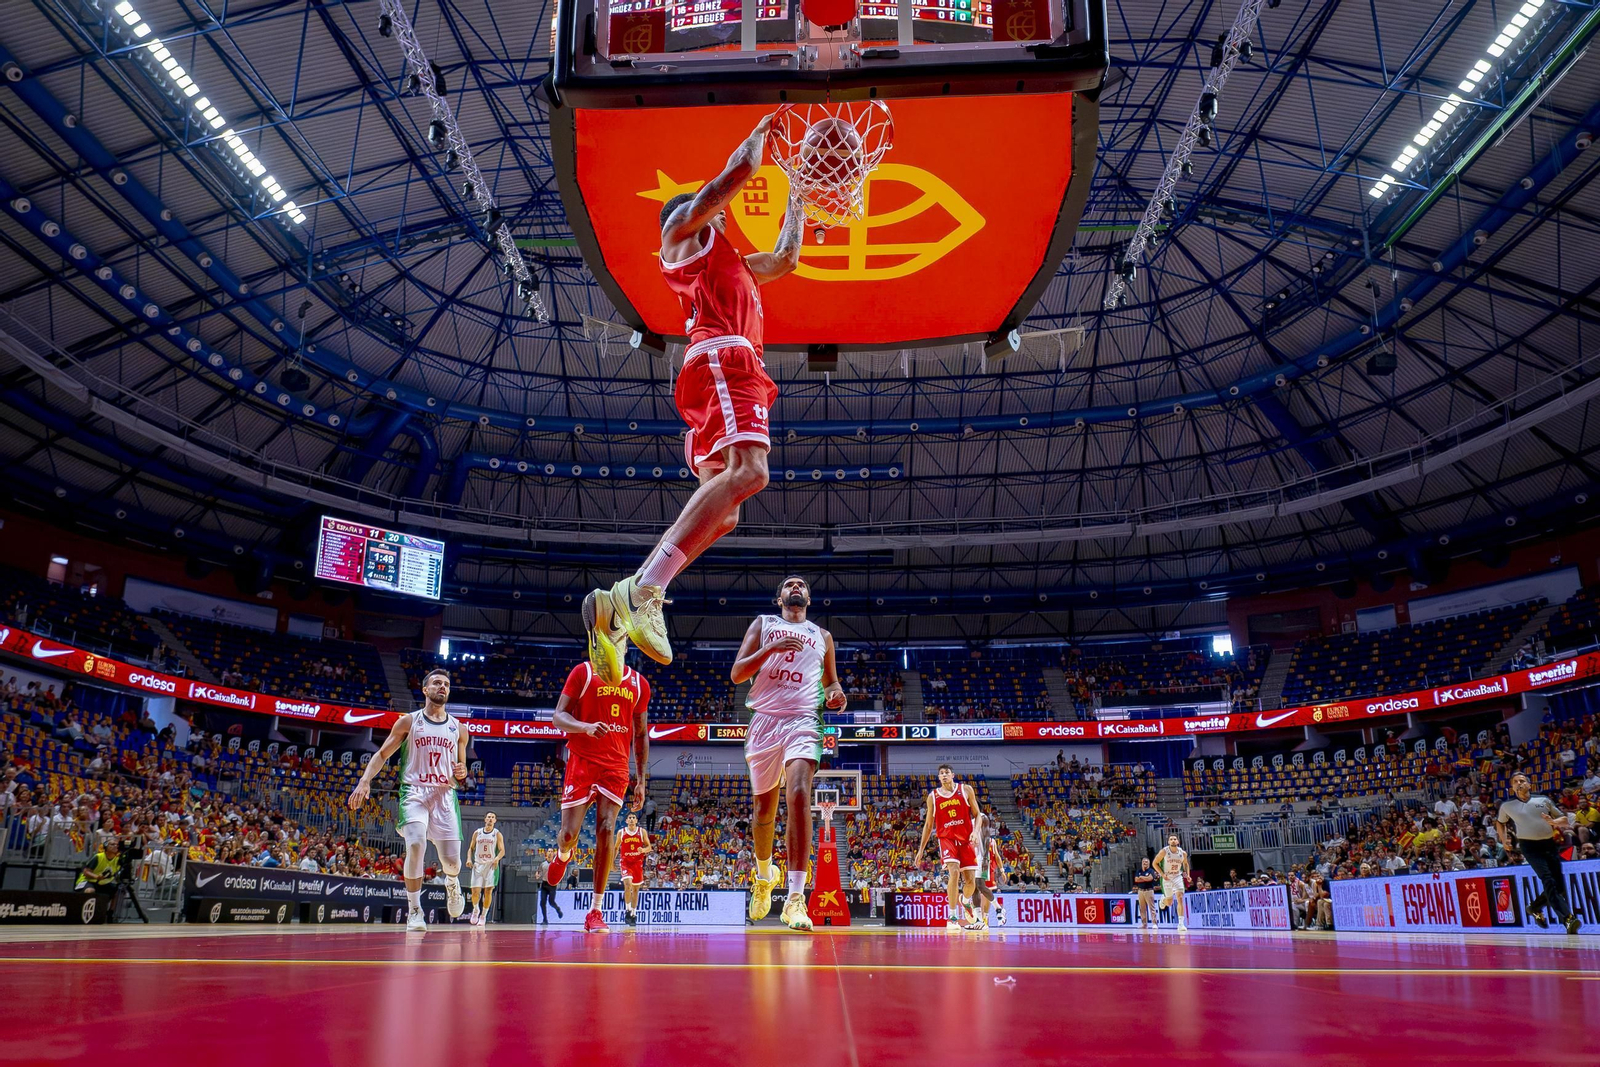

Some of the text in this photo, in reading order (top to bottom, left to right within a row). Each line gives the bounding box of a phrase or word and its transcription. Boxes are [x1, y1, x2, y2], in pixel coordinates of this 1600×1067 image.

[676, 6, 687, 15] 16
[676, 17, 686, 27] 17
[743, 176, 770, 217] FEB
[369, 528, 380, 539] 11
[387, 533, 400, 543] 20
[374, 552, 395, 564] 1:49
[785, 650, 796, 663] 3
[129, 673, 176, 693] endesa
[768, 668, 803, 684] una
[597, 686, 634, 703] ESPAÑA
[1454, 681, 1503, 700] CaixaBank
[207, 689, 251, 707] CaixaBank
[611, 703, 620, 718] 8
[1366, 698, 1420, 714] endesa
[462, 721, 491, 733] desa
[521, 725, 562, 736] CaixaBank
[881, 727, 897, 739] 23
[911, 727, 926, 739] 20
[951, 728, 997, 738] PORTUGAL
[1038, 725, 1085, 736] endesa
[1115, 723, 1160, 735] CaixaBank
[415, 736, 456, 754] PORTUGAL
[429, 751, 442, 768] 17
[419, 773, 449, 785] una
[948, 809, 957, 818] 16
[224, 875, 257, 890] endesa
[343, 885, 364, 896] endesa
[574, 892, 710, 911] MAID MISTAR ARENA
[1402, 872, 1458, 925] ESPAÑA
[812, 909, 844, 918] CaixaBank
[1017, 893, 1073, 925] ESPAÑA
[1499, 911, 1514, 921] DBB
[610, 911, 618, 922] DE
[652, 911, 673, 923] 20:00
[674, 912, 682, 923] H.
